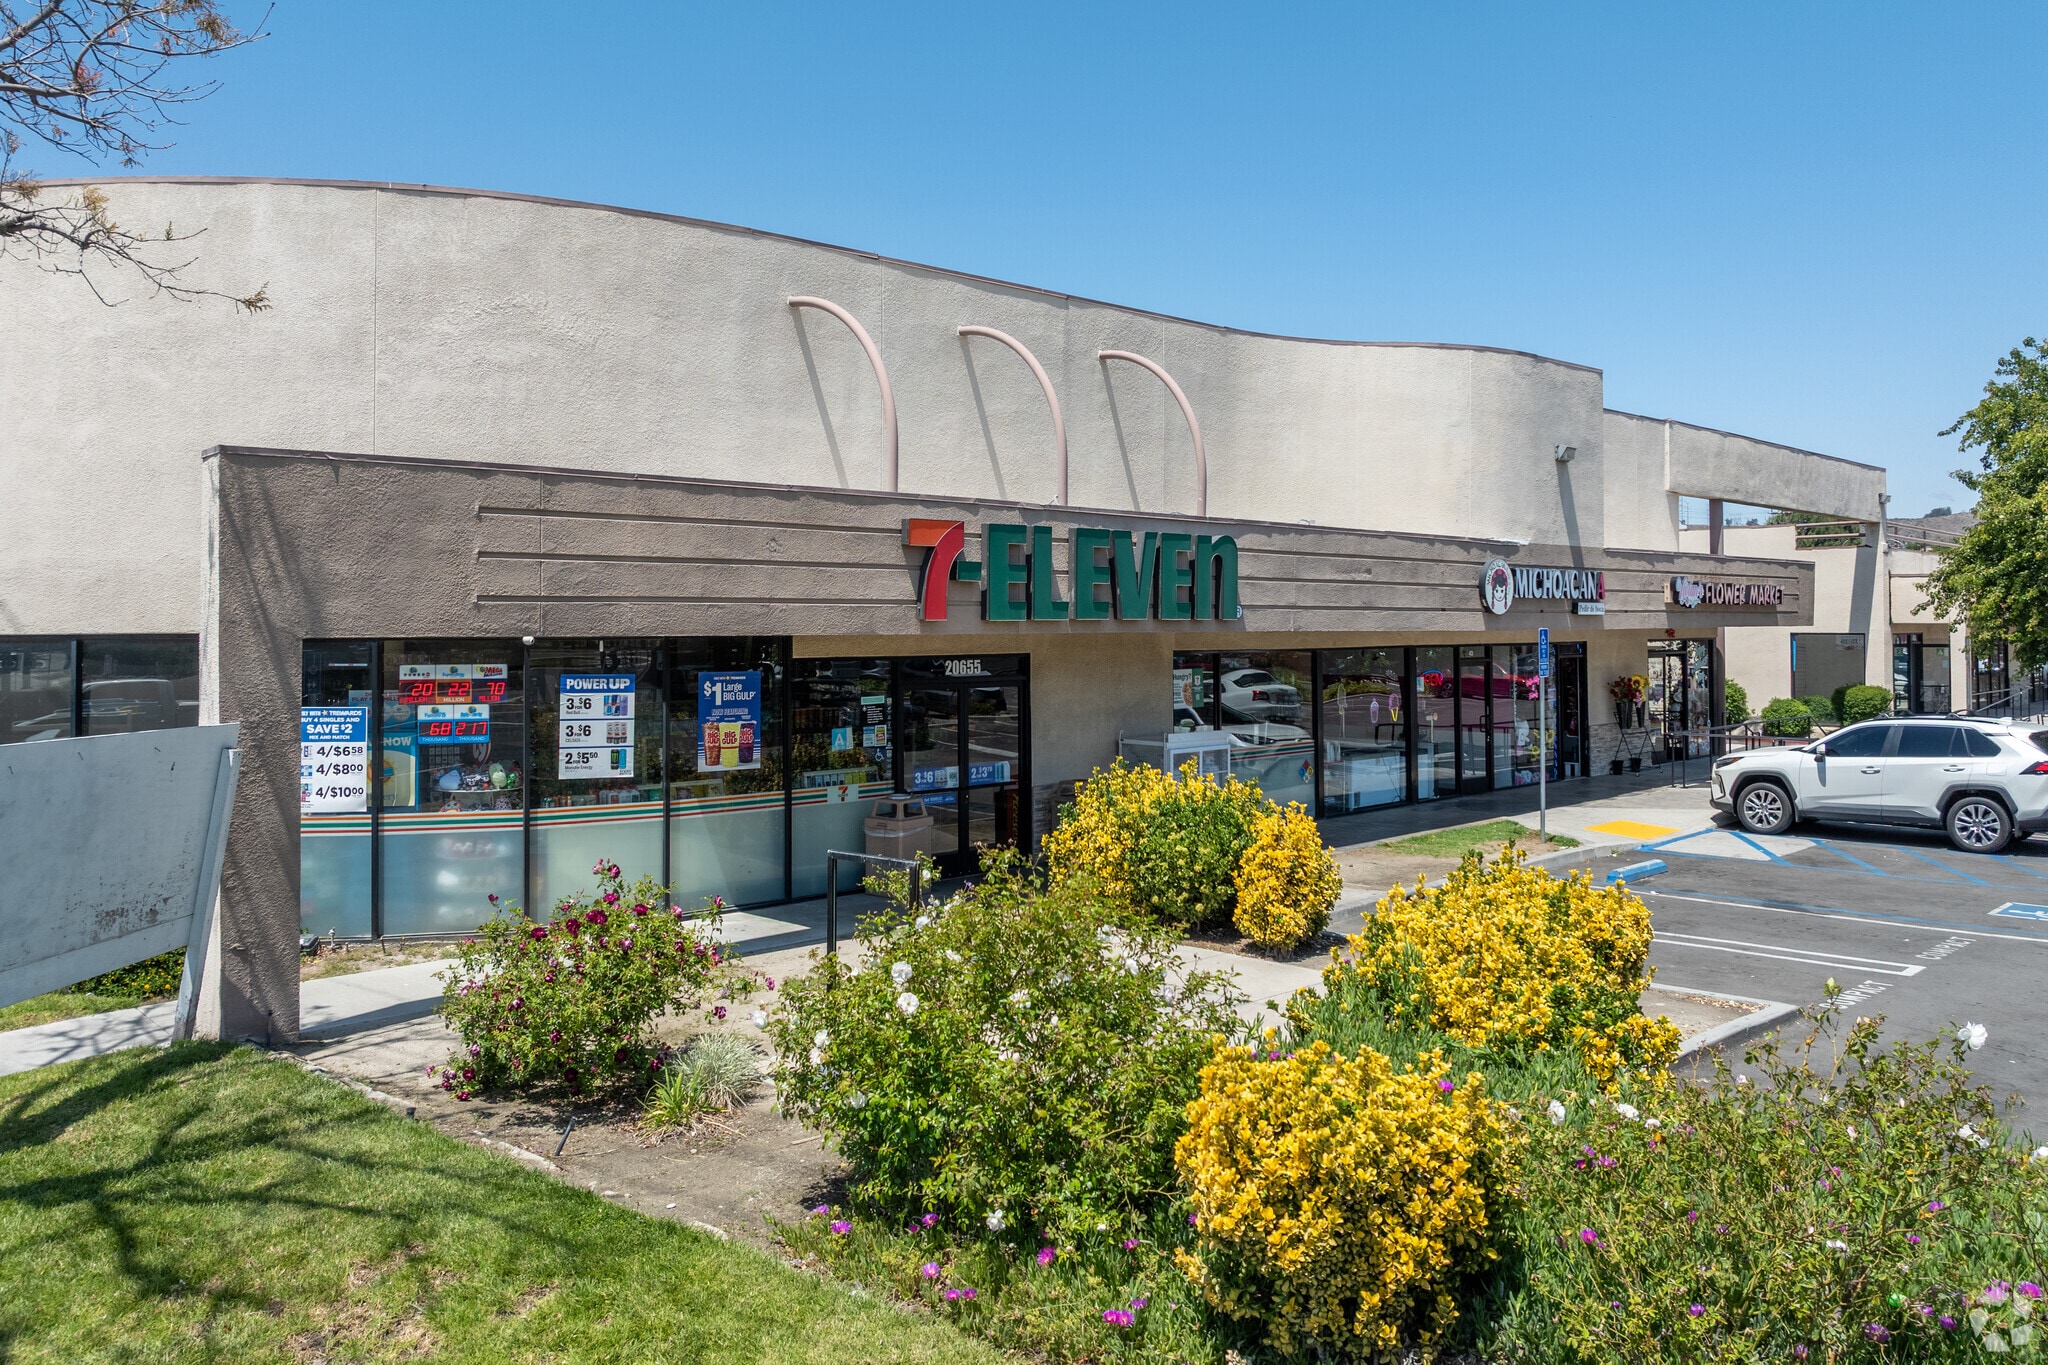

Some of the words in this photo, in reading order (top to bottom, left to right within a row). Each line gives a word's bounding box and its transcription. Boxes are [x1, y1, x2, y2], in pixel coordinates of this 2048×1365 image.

[1515, 567, 1605, 600] MICHOACANA
[1705, 582, 1746, 605] FLOWER
[1749, 584, 1784, 606] MARKET
[945, 659, 981, 675] 20655
[412, 684, 433, 696] 20
[448, 682, 470, 696] 22
[487, 682, 505, 695] 70
[566, 679, 608, 689] POWER
[609, 679, 631, 689] UP
[723, 683, 742, 693] Large
[704, 681, 722, 706] $1
[723, 692, 735, 700] BIG
[566, 698, 574, 710] 3
[579, 697, 592, 710] $6
[306, 724, 339, 733] SAVE
[340, 724, 352, 733] $2
[430, 722, 451, 735] 68
[565, 725, 574, 737] 3
[578, 724, 592, 737] $6
[722, 737, 737, 745] GULP
[834, 733, 845, 746] A
[564, 752, 573, 765] 2
[915, 772, 921, 784] 3
[971, 768, 977, 779] 2
[1915, 936, 1976, 960] COMPACT
